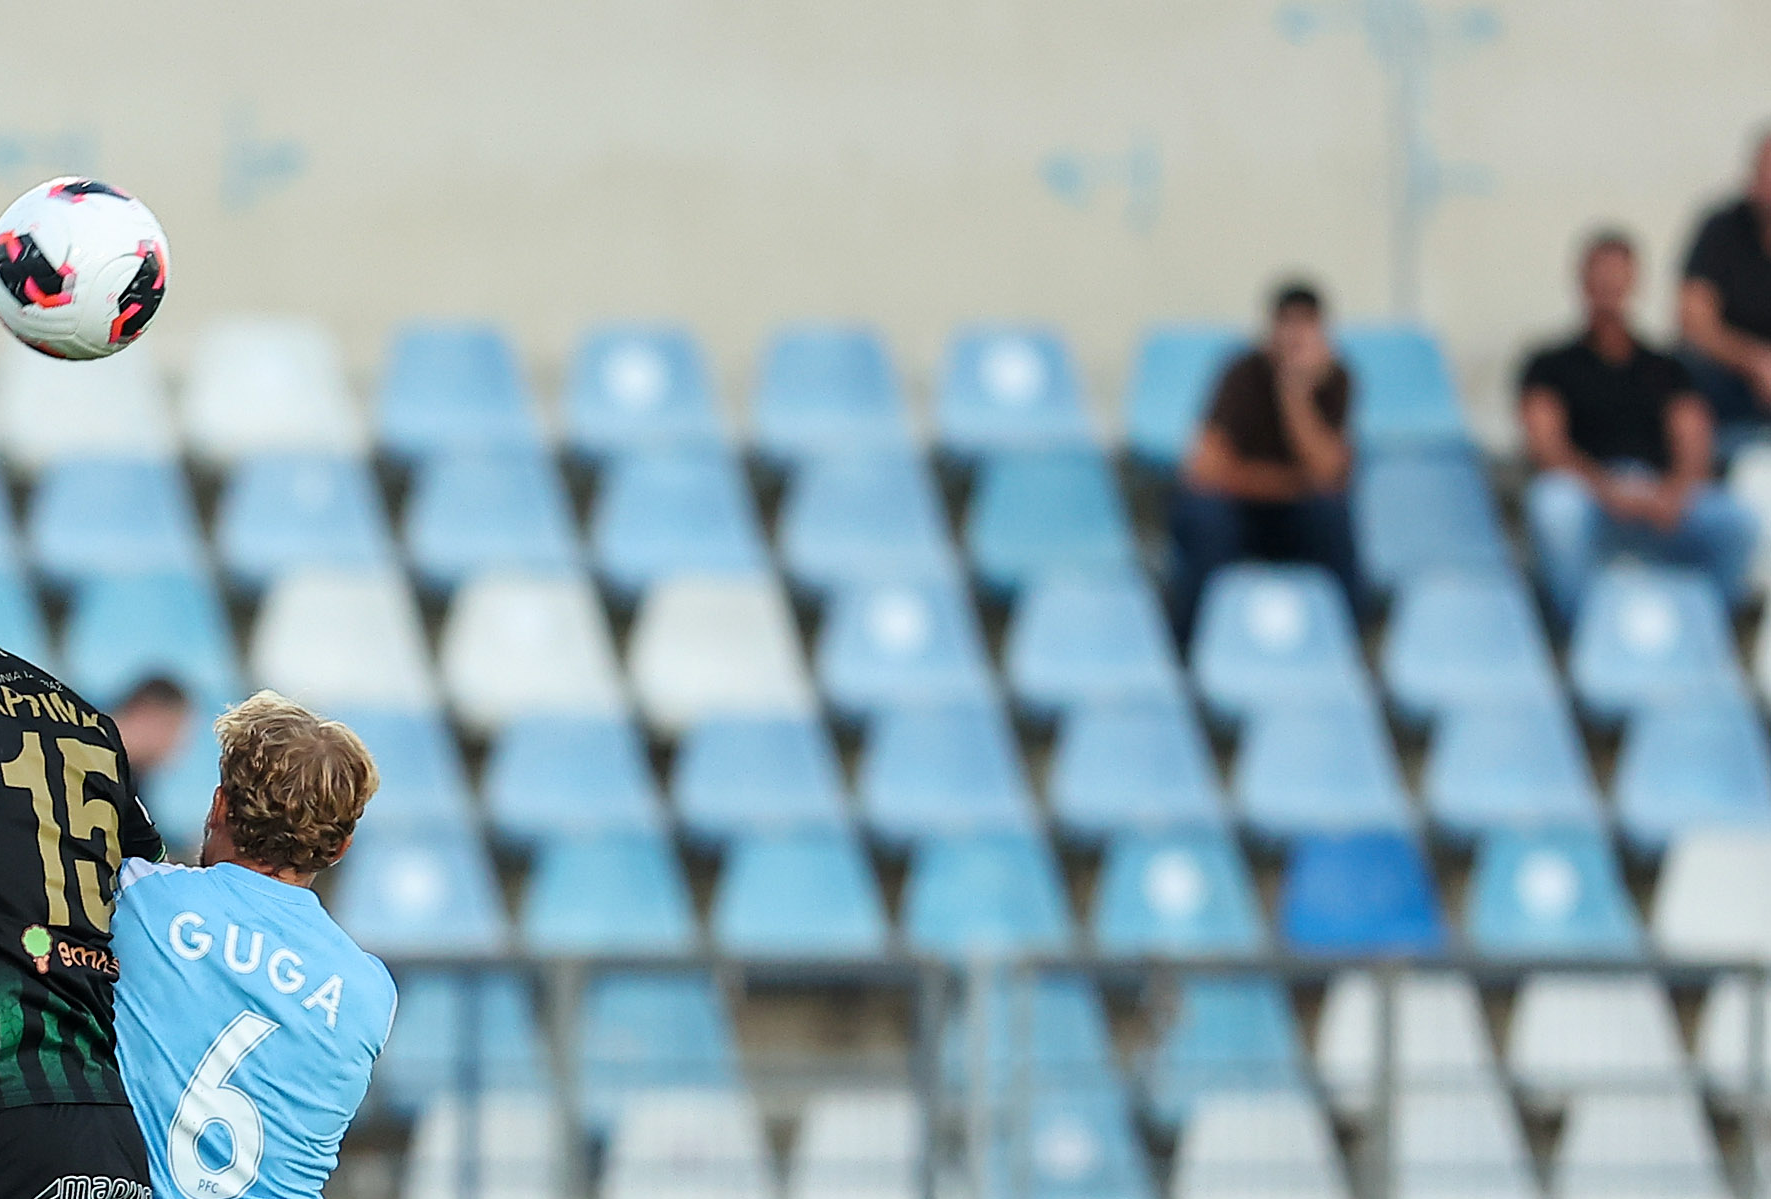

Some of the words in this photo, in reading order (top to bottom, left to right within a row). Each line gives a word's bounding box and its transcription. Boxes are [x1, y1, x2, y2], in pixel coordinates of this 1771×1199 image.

[0, 731, 122, 934] 15
[168, 910, 344, 1030] GUGA
[197, 1178, 219, 1195] PFC
